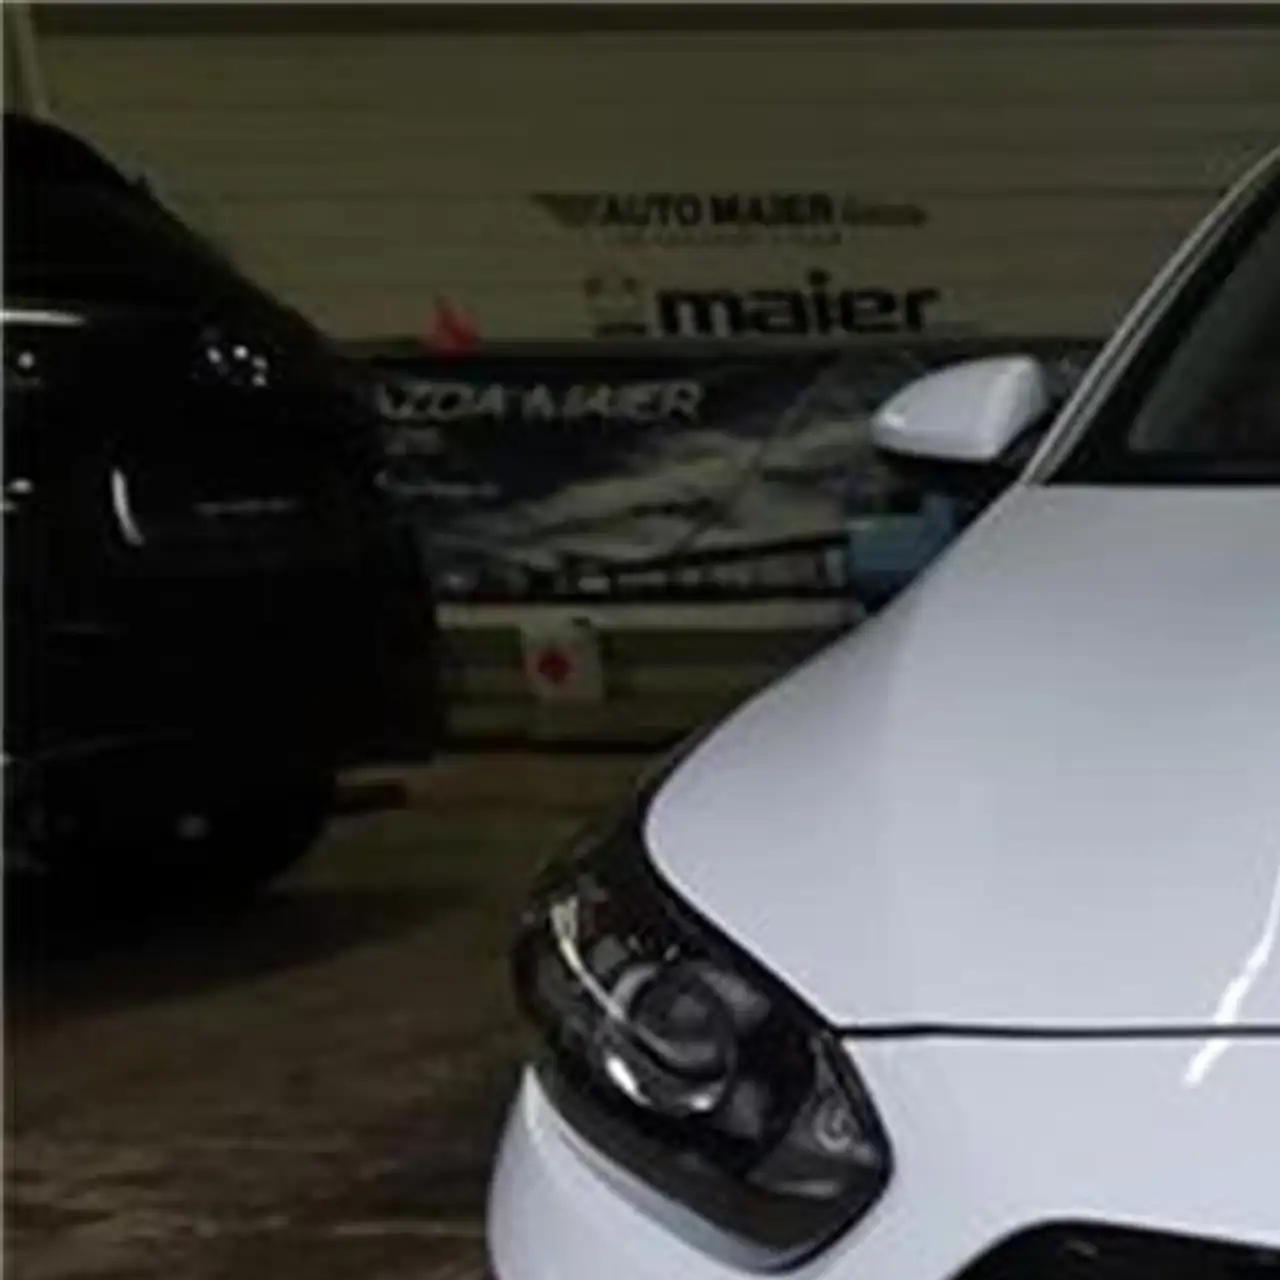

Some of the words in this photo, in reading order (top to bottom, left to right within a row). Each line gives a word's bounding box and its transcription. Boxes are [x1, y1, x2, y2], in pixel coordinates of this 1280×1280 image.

[602, 192, 702, 226] AUTO
[711, 192, 835, 227] MAIER
[656, 267, 941, 336] maier
